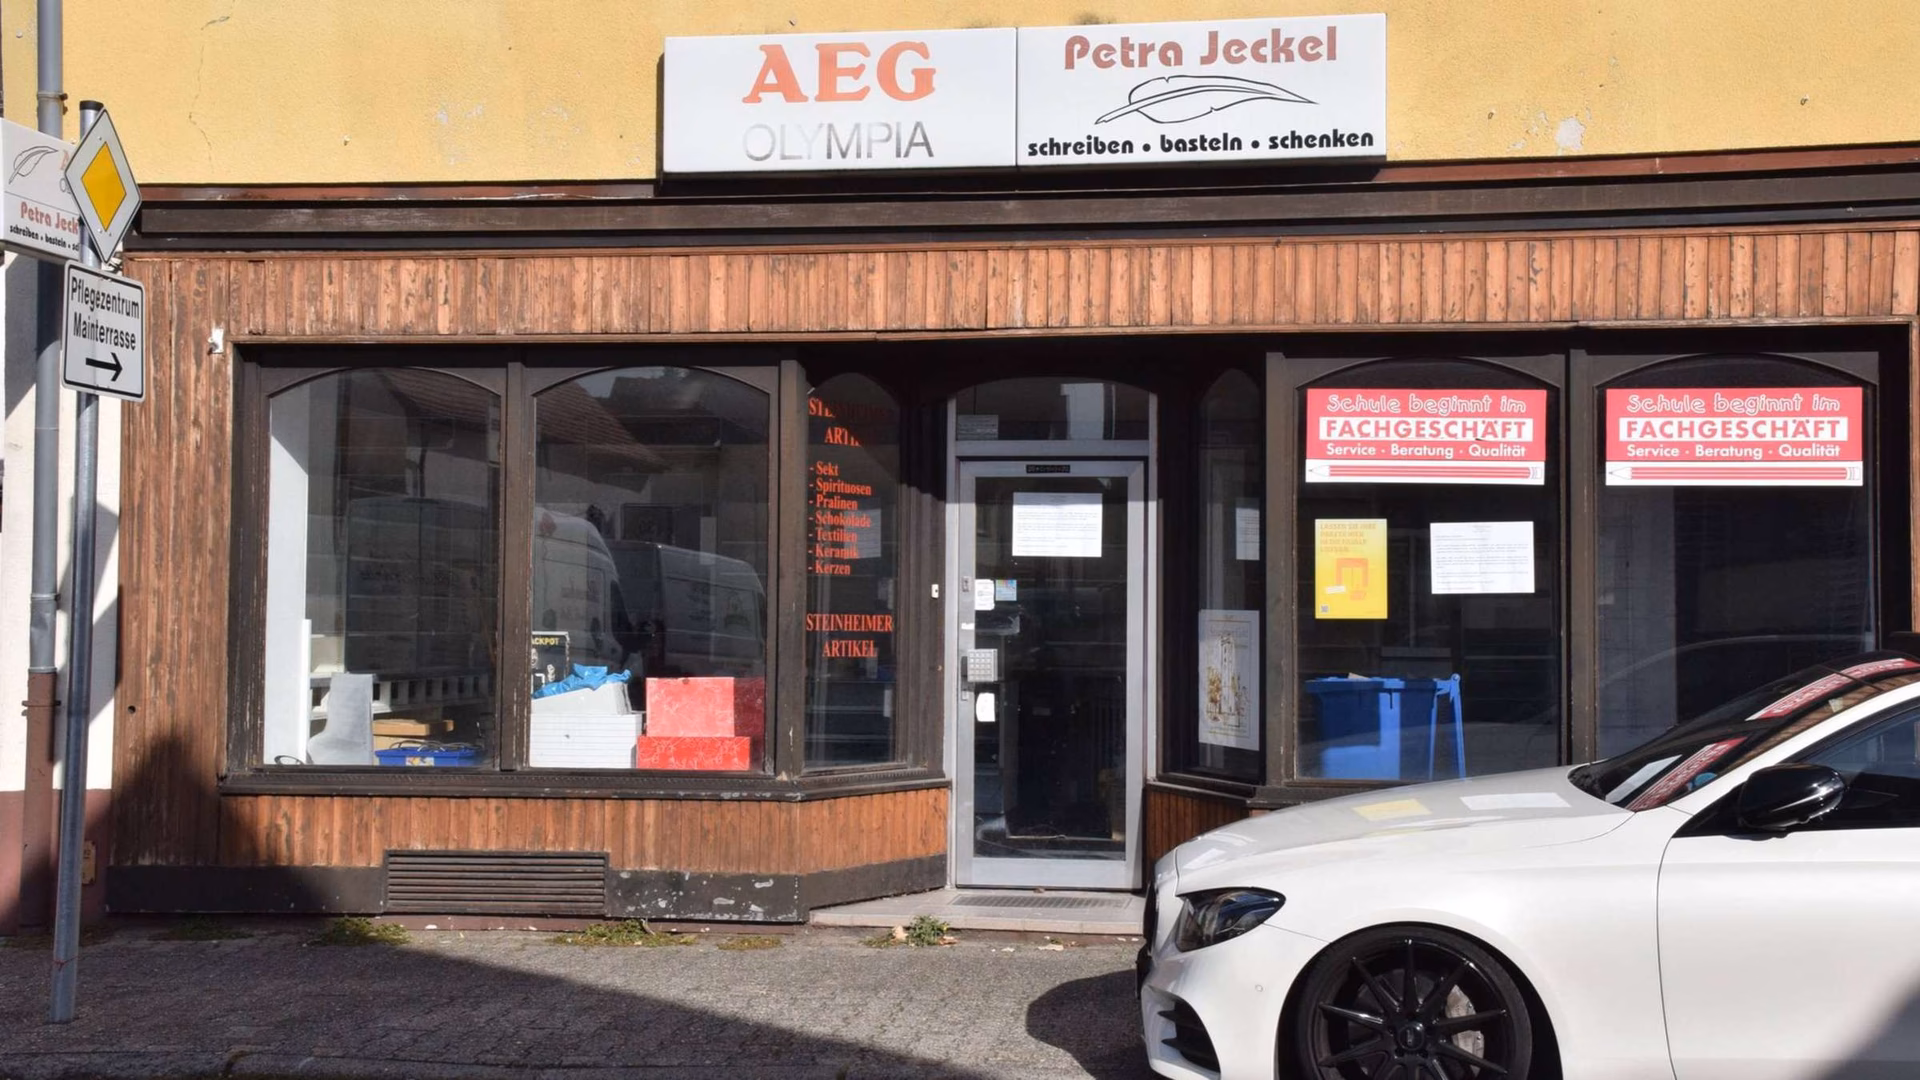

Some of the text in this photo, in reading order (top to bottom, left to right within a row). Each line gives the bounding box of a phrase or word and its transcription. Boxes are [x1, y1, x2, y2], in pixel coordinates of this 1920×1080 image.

[1065, 26, 1337, 70] Petra Jeckel
[742, 41, 936, 104] AEG
[742, 121, 935, 161] OLYMPIA
[1028, 129, 1374, 156] schreiben basteln schenken
[20, 201, 79, 235] Petra Jeck
[10, 224, 39, 241] schreiben
[45, 233, 66, 249] basteln
[71, 276, 140, 319] Pflegezentrum
[73, 311, 137, 351] Mainterrasse
[1327, 393, 1527, 416] Schule beginnt im
[1626, 392, 1840, 416] Schule beginnt im
[1326, 419, 1527, 439] FACHGESCHÄFT
[1626, 418, 1841, 439] FACHGESCHÄFT
[1326, 443, 1526, 459] Service Beratung Qualität
[1627, 443, 1841, 460] Service Beratung Qualität
[816, 461, 838, 476] Sekt
[816, 477, 872, 496] Spirituosen
[817, 494, 858, 511] Pralinen
[816, 511, 871, 528] Schokolade
[816, 560, 850, 576] Kerzen
[806, 612, 894, 632] STEINHEIMER
[532, 637, 560, 645] CKPOT
[822, 640, 879, 658] ARTIKEL
